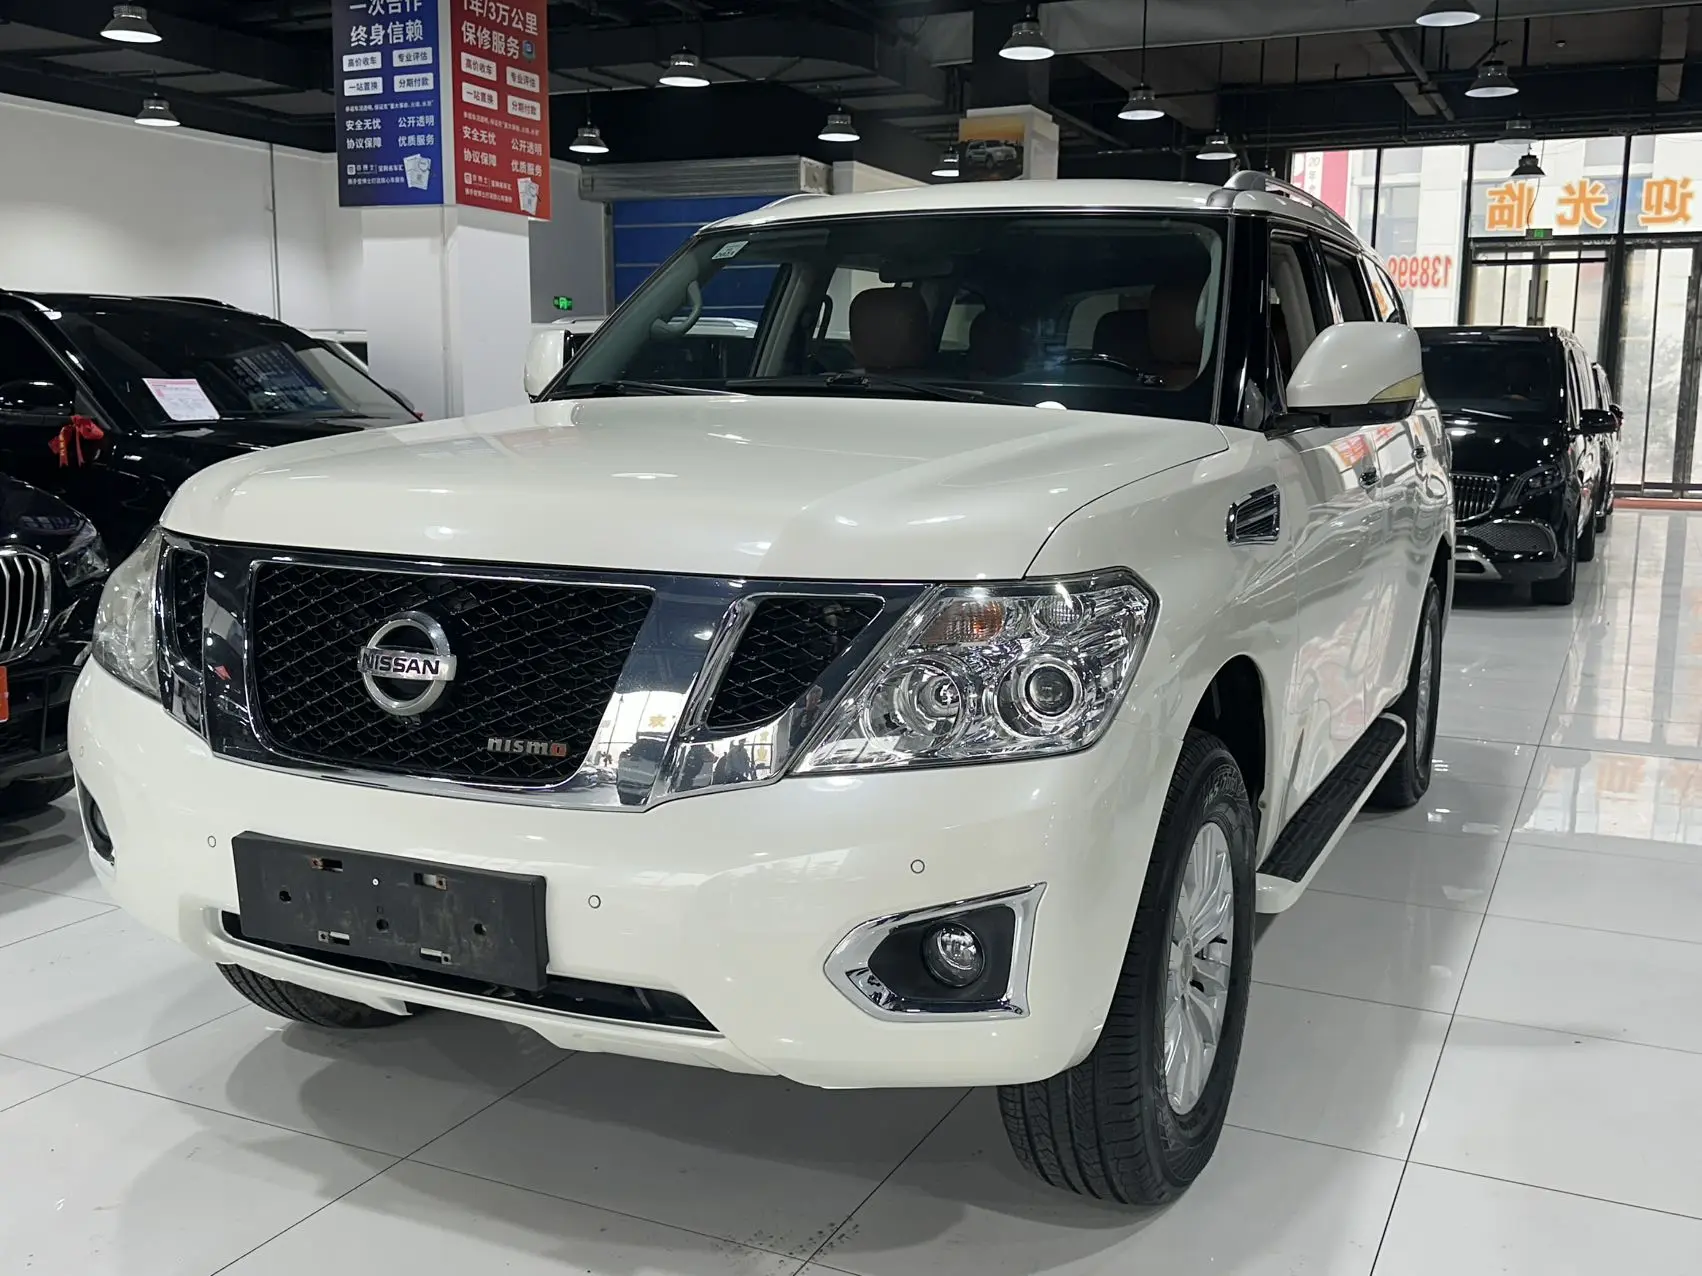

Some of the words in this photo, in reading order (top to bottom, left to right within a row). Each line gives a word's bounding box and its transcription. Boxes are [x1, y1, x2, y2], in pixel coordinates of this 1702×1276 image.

[350, 0, 422, 16] 一次合作
[350, 19, 423, 47] 终身信赖
[462, 20, 520, 60] 保修服务
[348, 56, 377, 67] 高价收车
[398, 52, 428, 62] 专业评估
[465, 58, 493, 75] 高价收车
[348, 81, 378, 91] 一站置换
[399, 77, 429, 88] 分期付款
[345, 117, 382, 131] 安全无忧
[398, 115, 435, 128] 公开透明
[346, 136, 382, 150] 协议保障
[398, 134, 435, 147] 优质服务
[462, 125, 496, 146] 安全无忧
[511, 138, 543, 156] 公开透明
[463, 147, 497, 167] 协议保障
[510, 160, 543, 178] 优质服务
[360, 652, 441, 675] NISSAN
